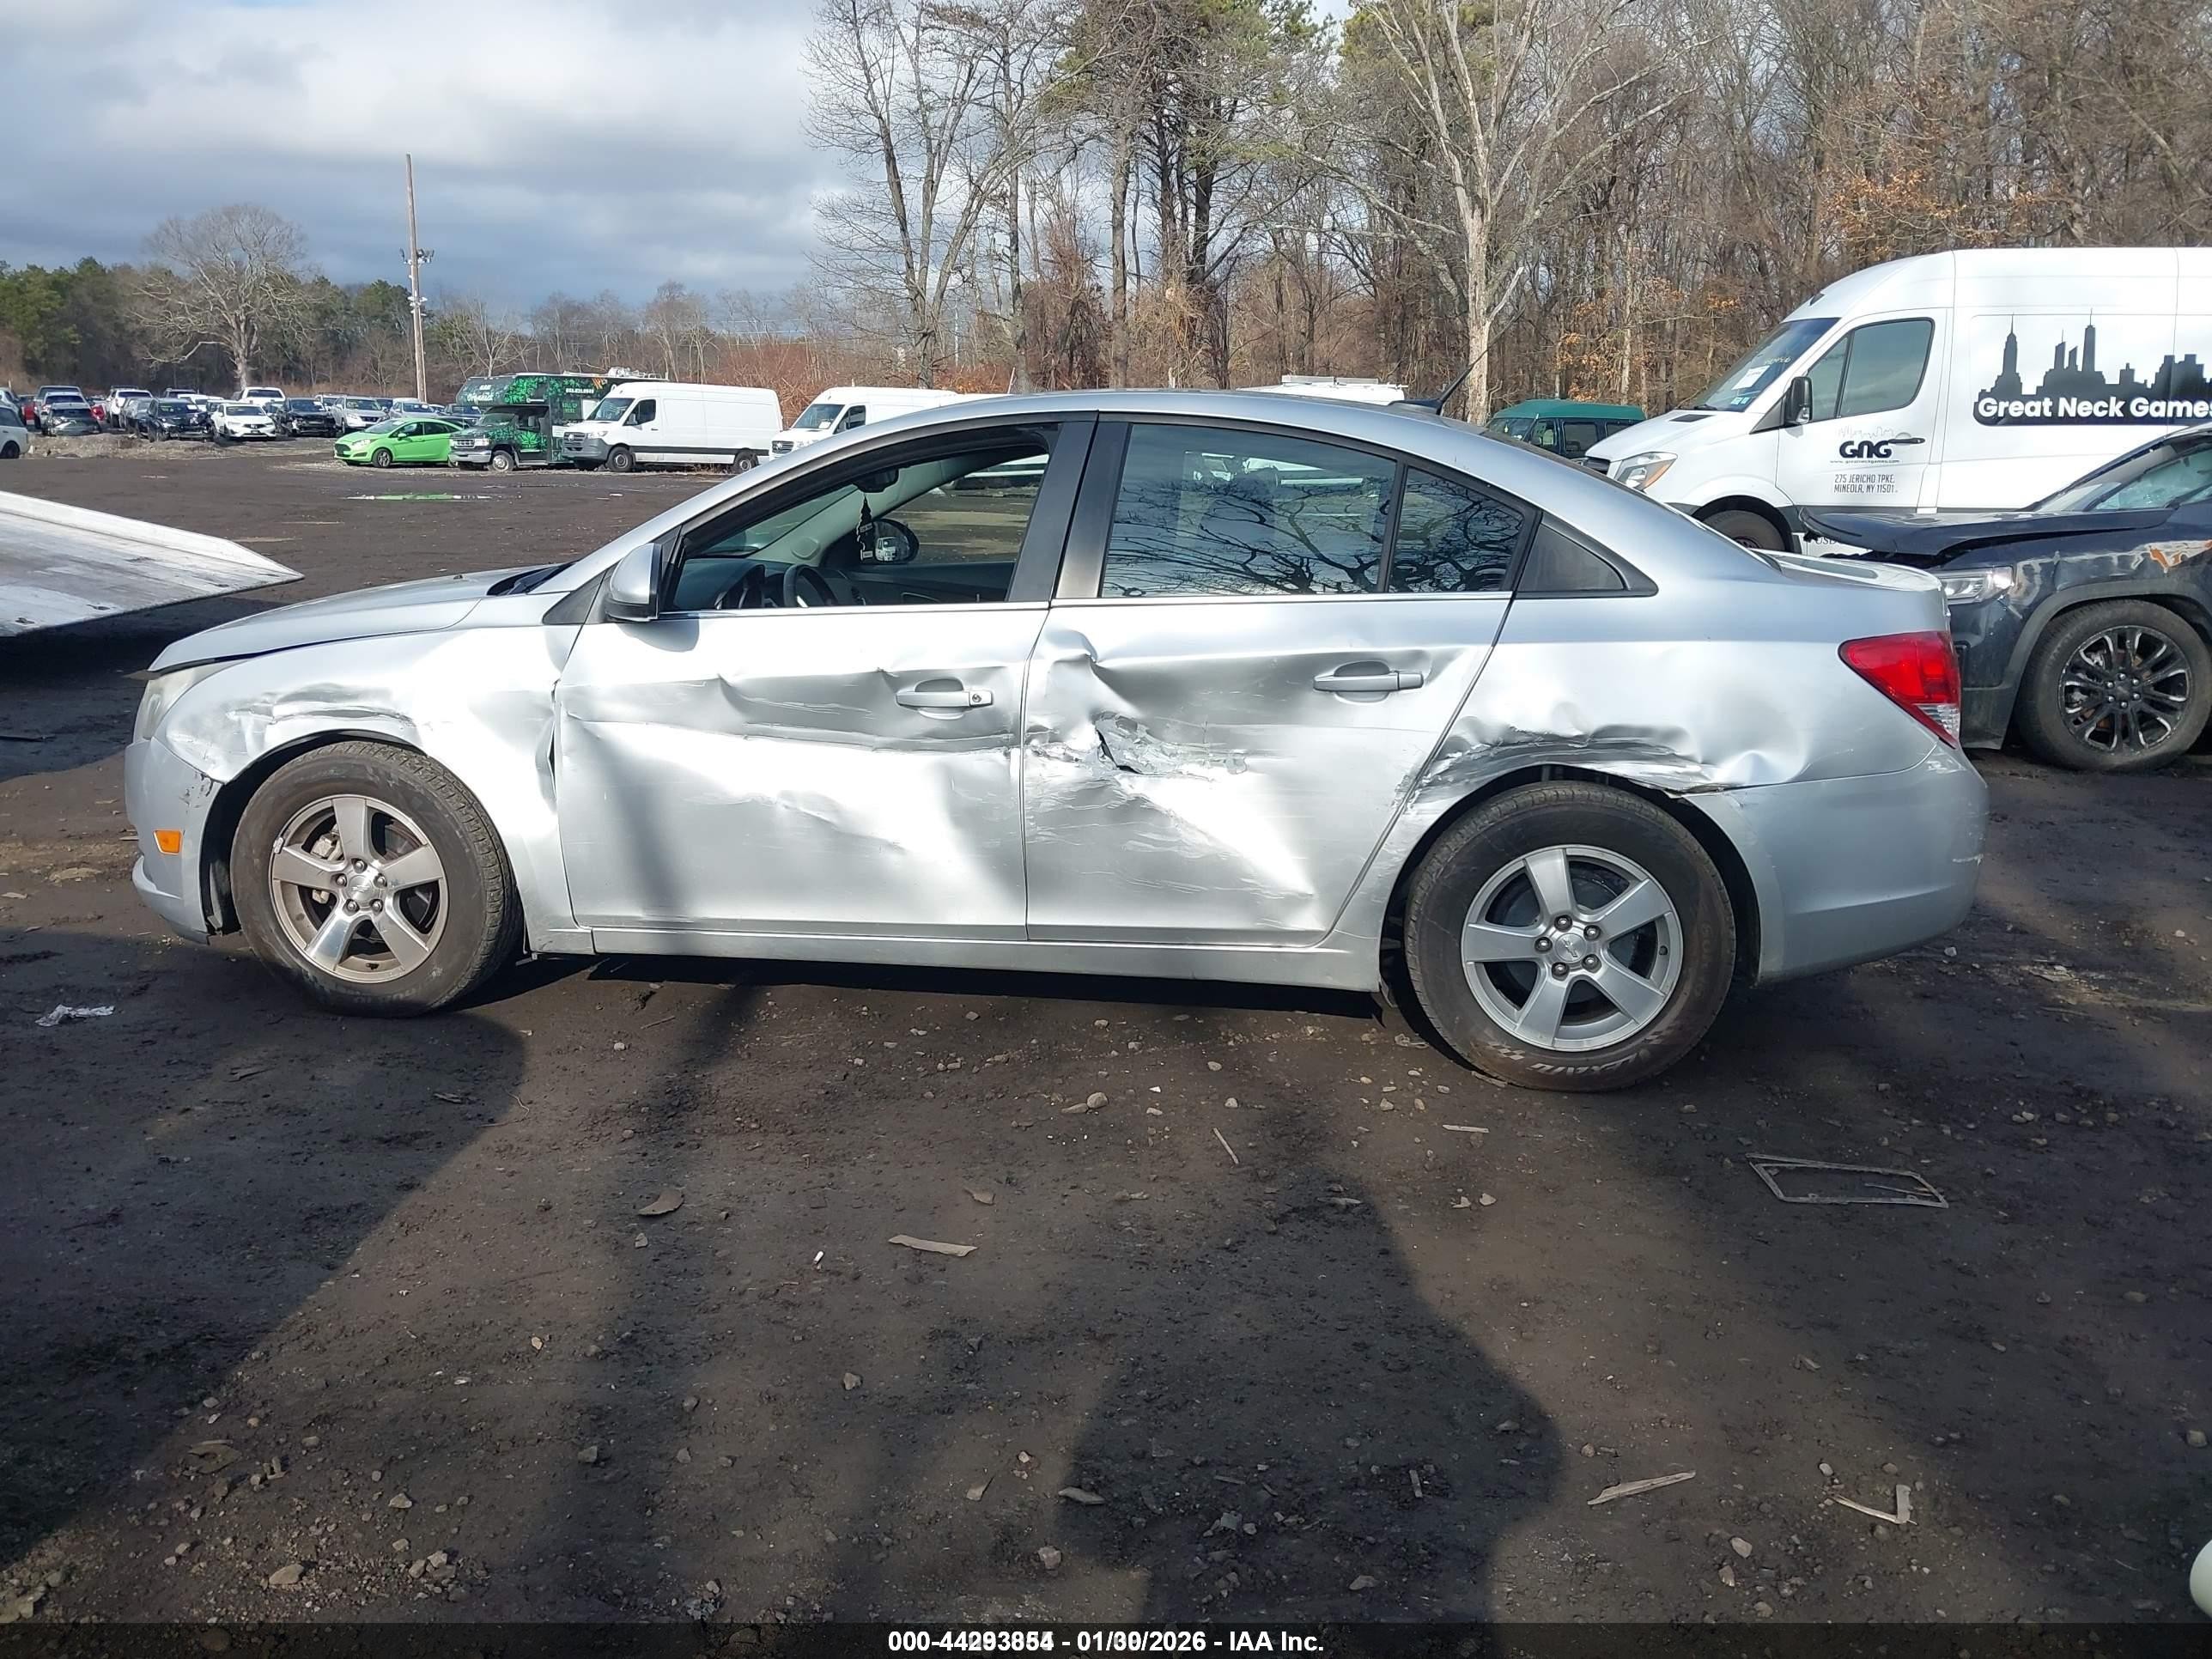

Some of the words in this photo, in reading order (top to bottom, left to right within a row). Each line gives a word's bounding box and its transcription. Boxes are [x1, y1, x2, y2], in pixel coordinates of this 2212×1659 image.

[1978, 397, 2053, 418] Great
[2058, 396, 2125, 417] Neck
[2130, 397, 2212, 418] Game
[1834, 474, 1847, 483] 275
[1848, 474, 1876, 483] JERICHO
[1866, 484, 1875, 493] NY
[1876, 484, 1894, 494] 11501
